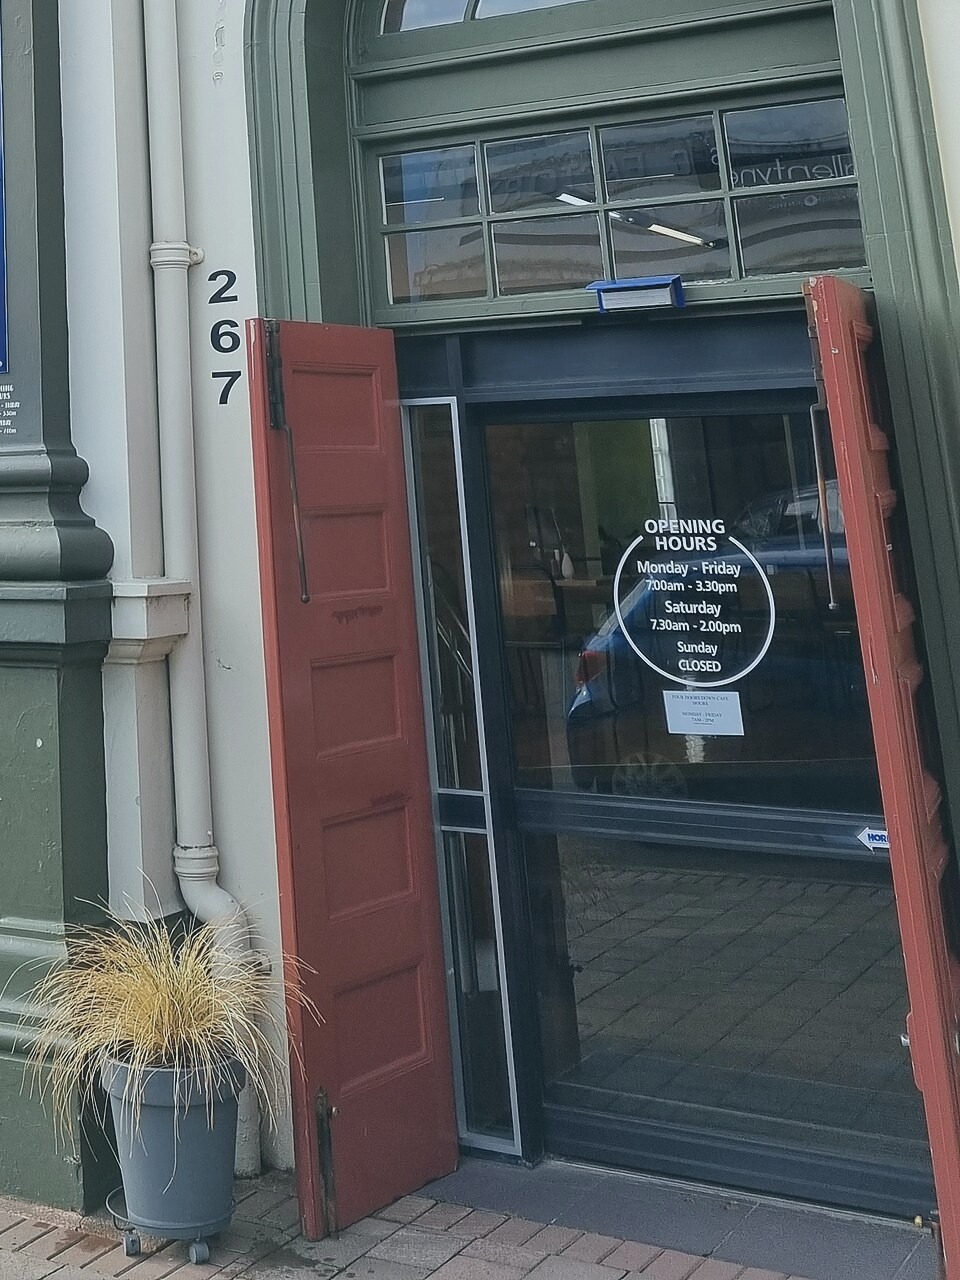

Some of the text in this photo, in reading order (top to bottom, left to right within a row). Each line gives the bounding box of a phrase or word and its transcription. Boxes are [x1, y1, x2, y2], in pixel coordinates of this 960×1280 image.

[207, 269, 242, 405] 267
[644, 519, 726, 534] OPENING
[655, 536, 717, 551] HOURS
[637, 560, 689, 577] Monday
[701, 561, 741, 577] Friday
[695, 581, 737, 595] 3.30pm
[664, 600, 722, 617] Saturday
[650, 619, 690, 631] 7.30am
[699, 620, 742, 635] 2.00pm
[677, 641, 718, 656] Sunday
[678, 659, 722, 672] CLOSED
[867, 833, 889, 842] HOR
